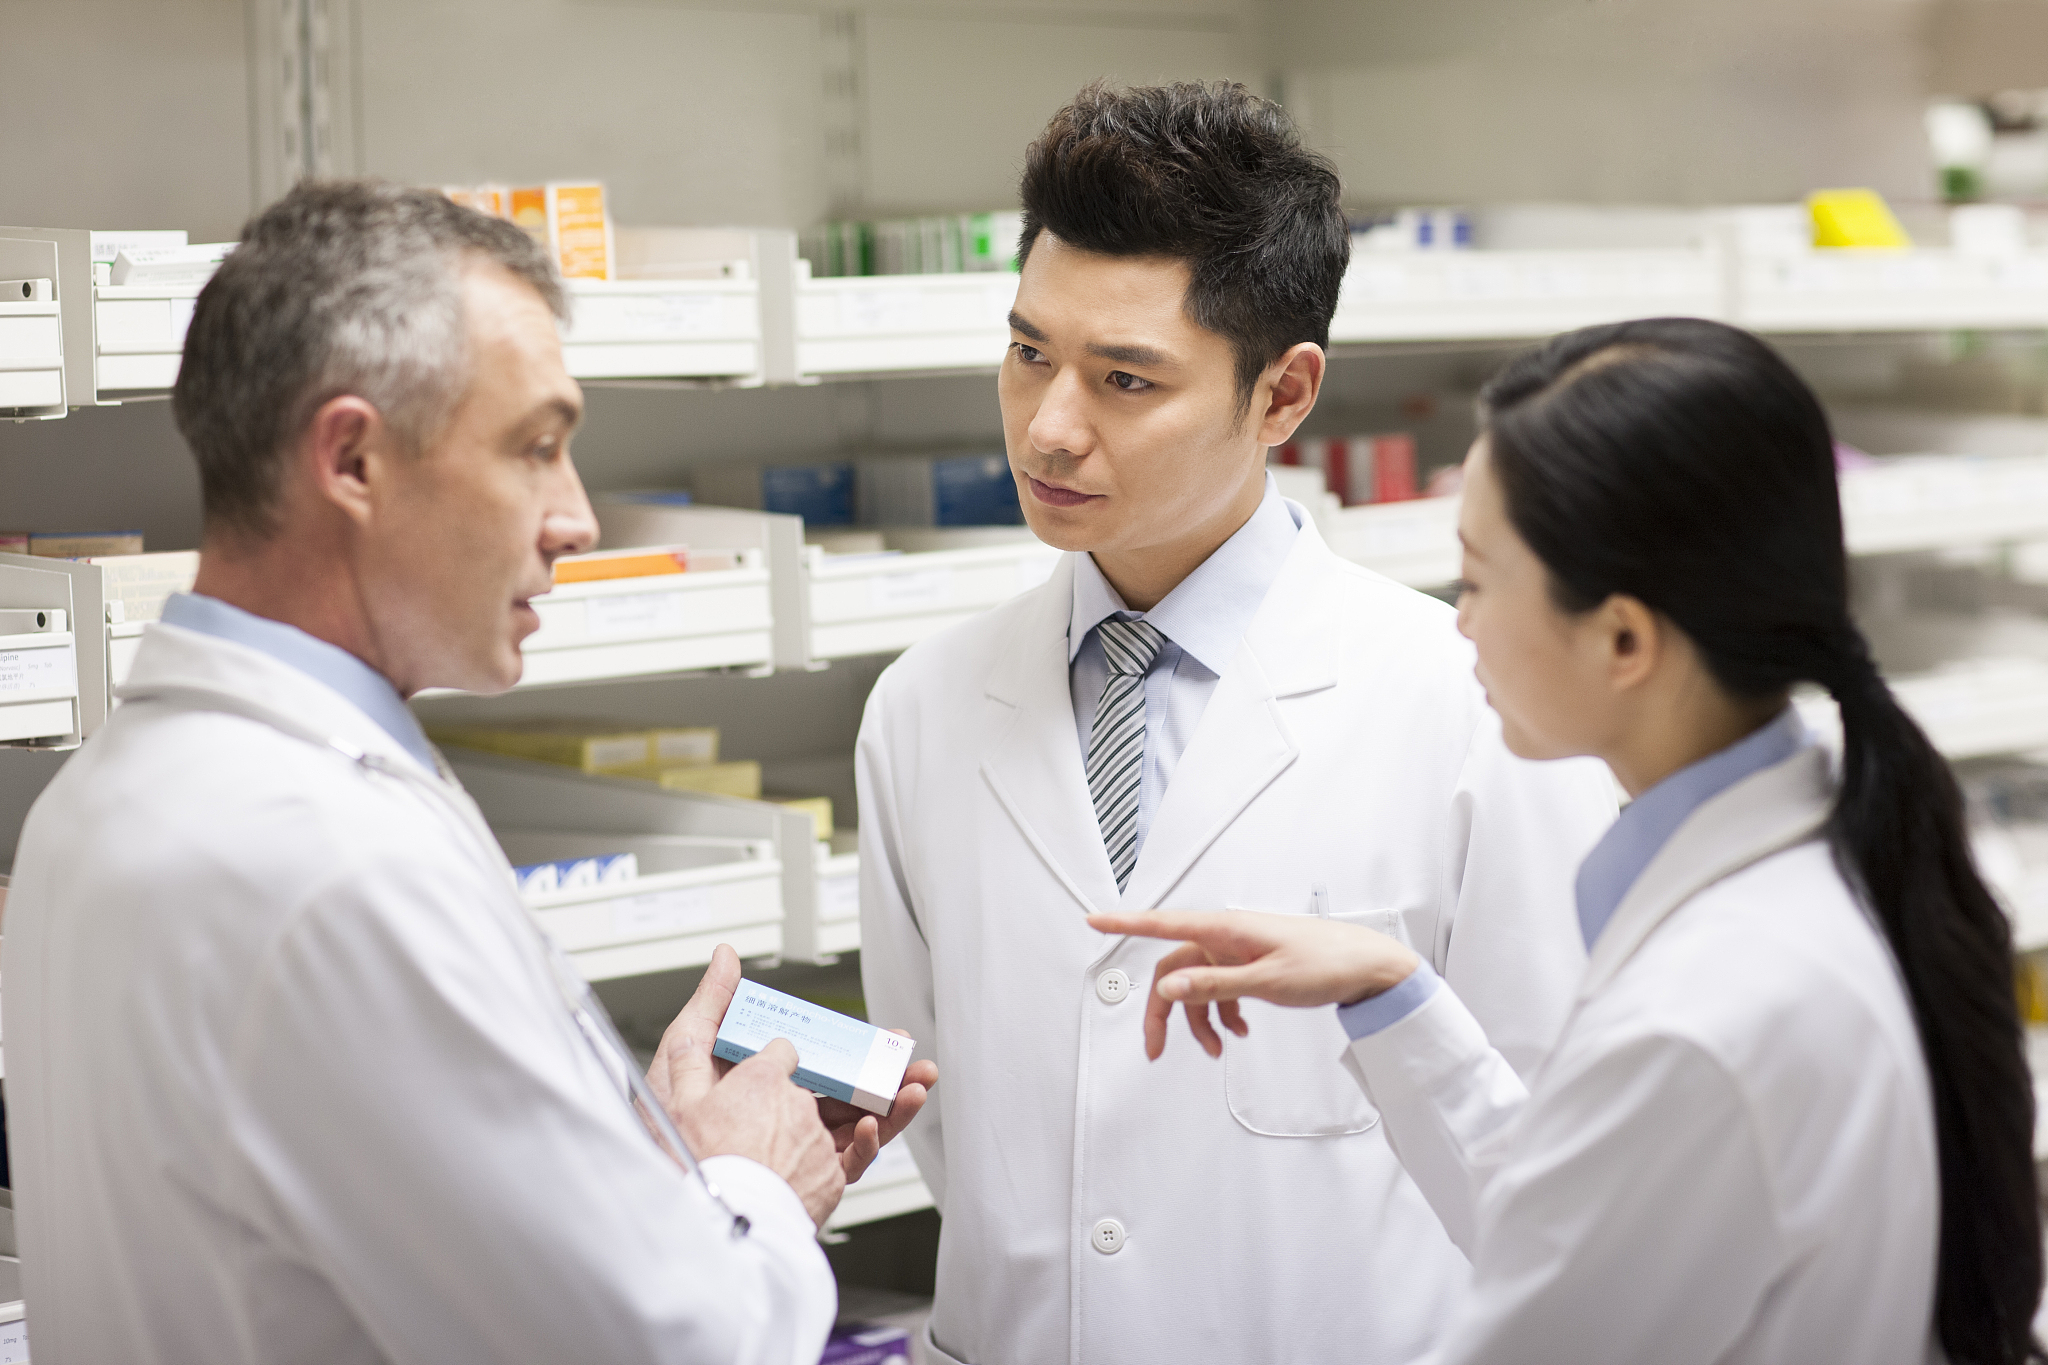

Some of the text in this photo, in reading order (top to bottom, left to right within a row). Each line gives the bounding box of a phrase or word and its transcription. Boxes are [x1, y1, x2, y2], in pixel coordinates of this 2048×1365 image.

[0, 653, 19, 663] ipine
[744, 995, 812, 1025] 细菌溶解产物
